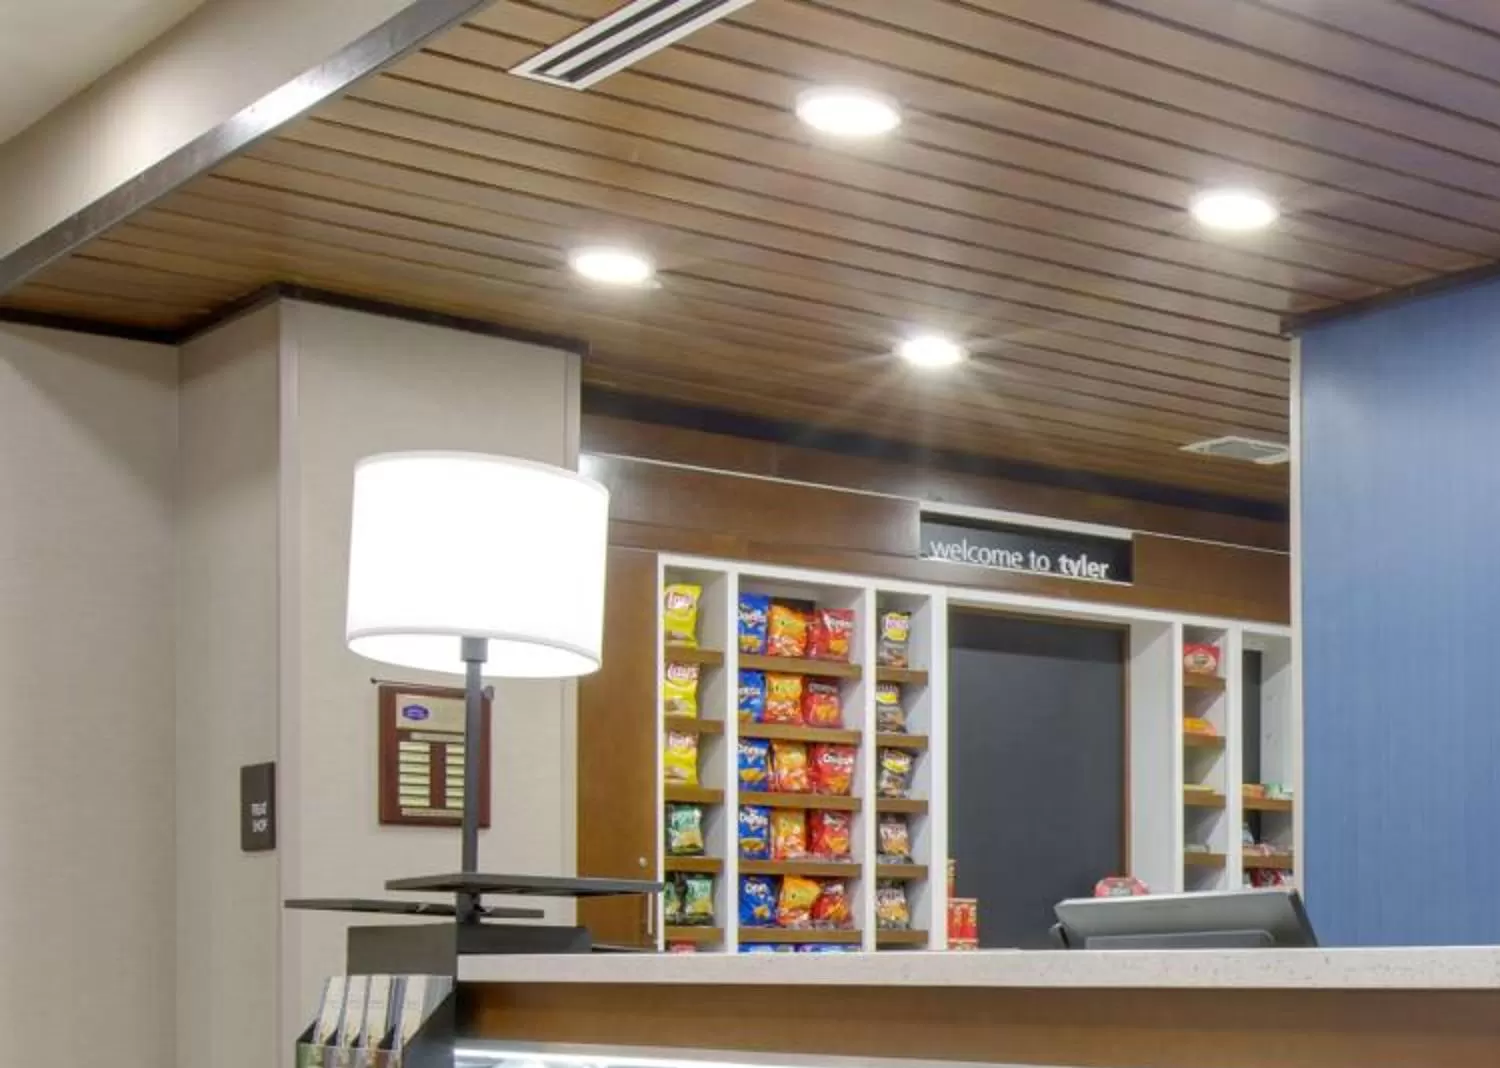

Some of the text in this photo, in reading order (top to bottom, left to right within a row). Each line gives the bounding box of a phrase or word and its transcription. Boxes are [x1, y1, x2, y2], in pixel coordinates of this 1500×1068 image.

[930, 537, 1110, 579] welcome to tyler
